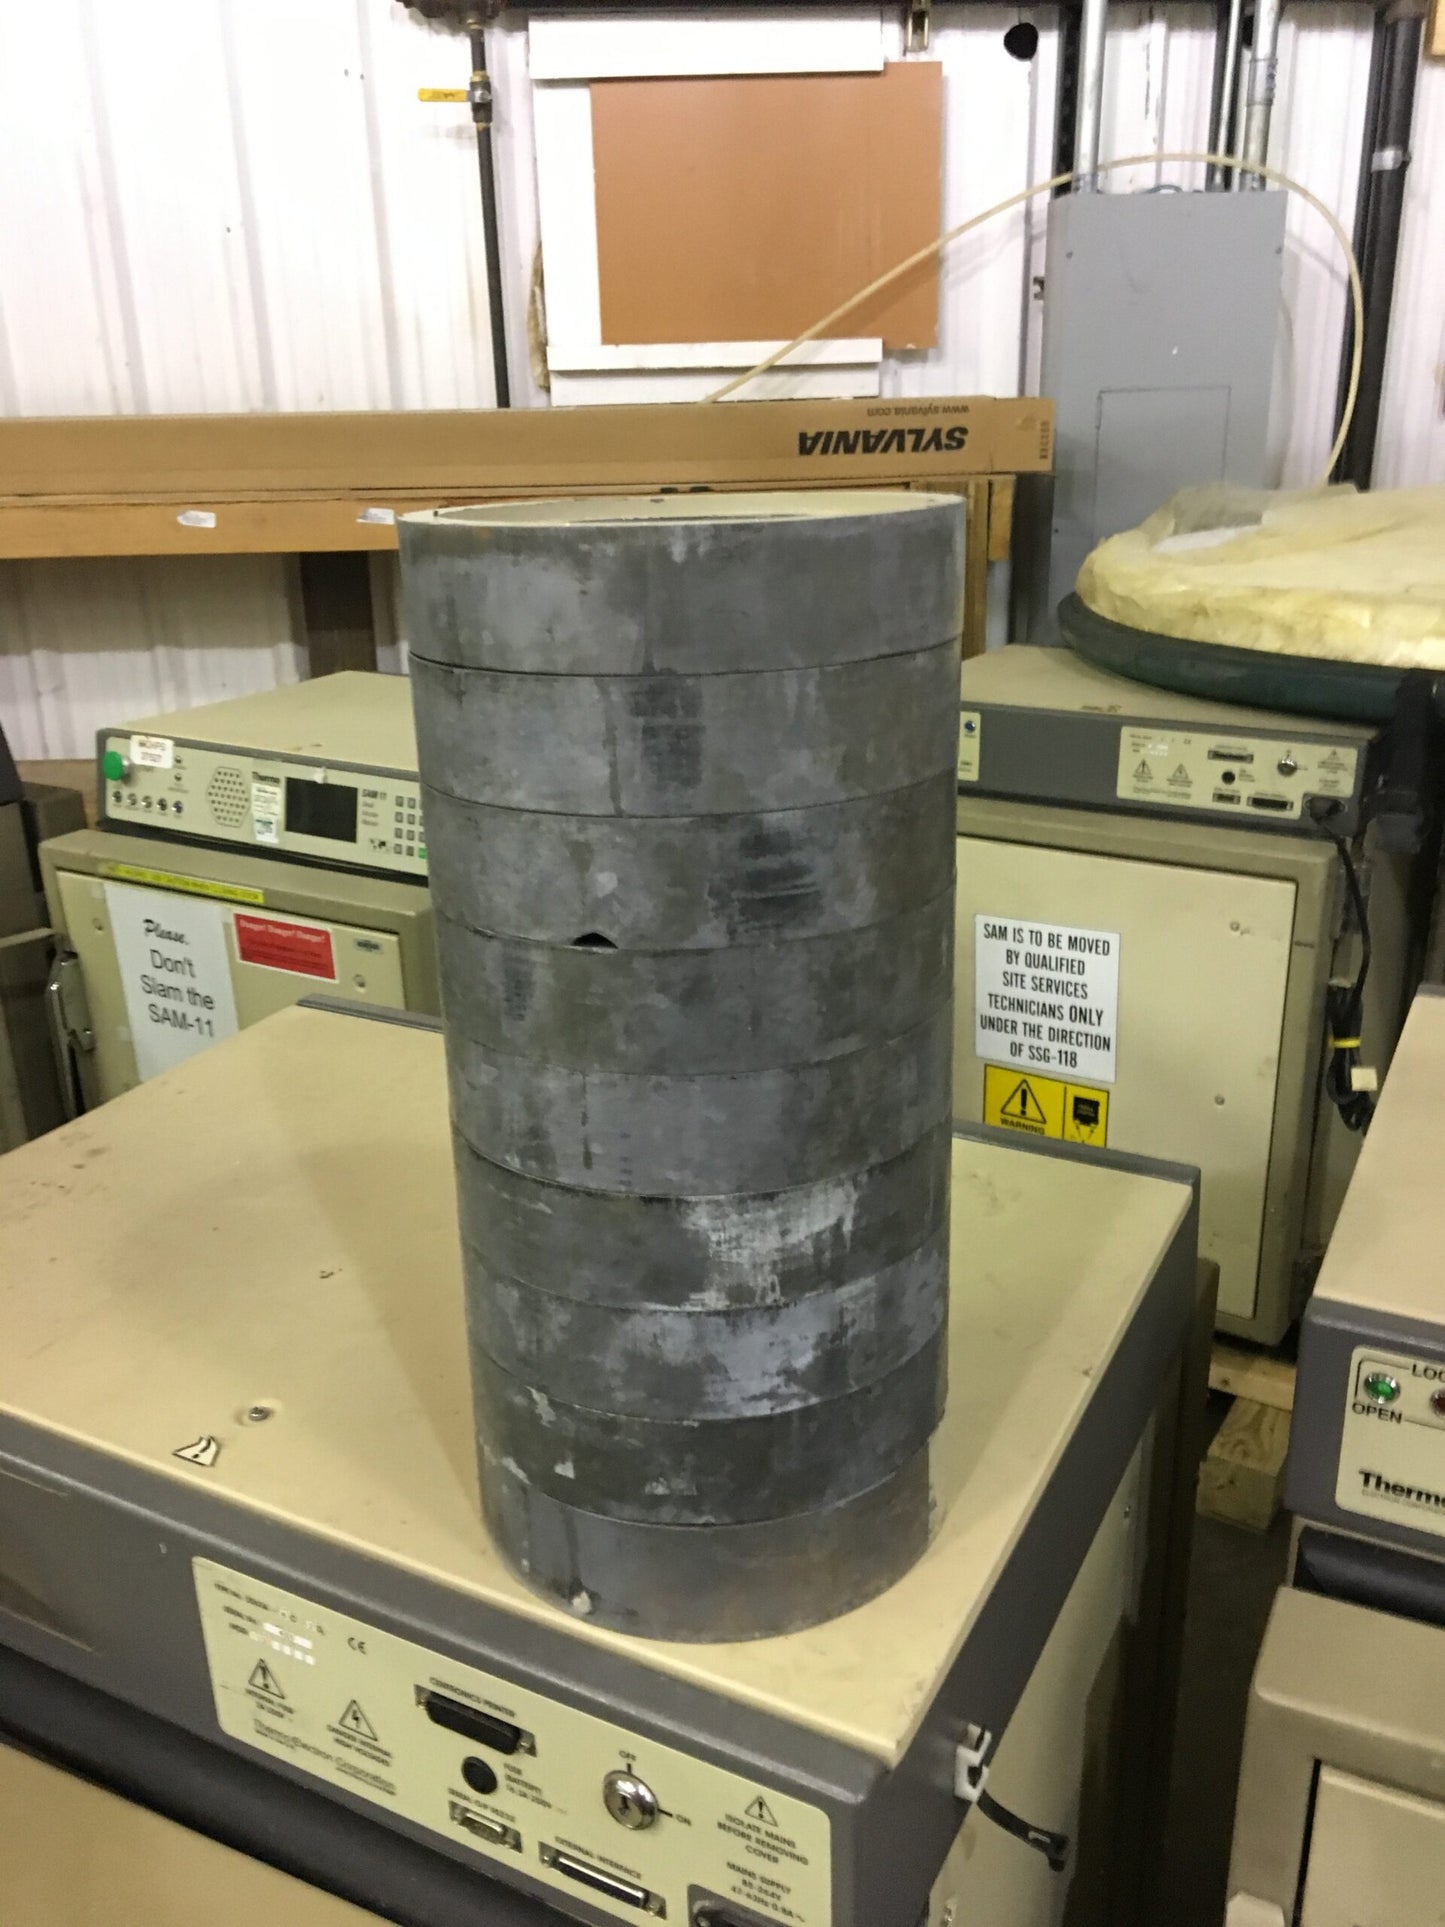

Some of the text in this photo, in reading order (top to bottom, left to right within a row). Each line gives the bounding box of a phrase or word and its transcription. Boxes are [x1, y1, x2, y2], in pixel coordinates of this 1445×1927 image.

[867, 405, 969, 417] www.sylvania.com
[798, 426, 969, 456] SYLVANIA
[983, 923, 1110, 956] SAM IS TO BE MOVED
[150, 949, 197, 979] Don't
[1006, 949, 1085, 976] BY QUALIFIED
[140, 974, 215, 1010] Slam the
[1002, 971, 1088, 1000] SITE SERVICES
[148, 1003, 214, 1037] SAM-11
[988, 993, 1104, 1027] TECHNICIANS ONLY
[980, 1014, 1111, 1052] UNDER THE DIRECTION
[1010, 1041, 1078, 1069] OF SSG-118
[1000, 1117, 1046, 1136] WARNING
[1352, 1402, 1403, 1425] OPEN
[347, 1636, 367, 1655] CE
[429, 1676, 516, 1718] CENTRONICS PRINTER
[619, 1750, 637, 1762] OFF
[676, 1814, 693, 1827] ON
[725, 1813, 797, 1849] ISOLATE MAINS
[554, 1835, 642, 1881] EXTERNAL INTERFACE
[717, 1821, 809, 1866] BEFORE REMOVING
[745, 1844, 779, 1864] COVER
